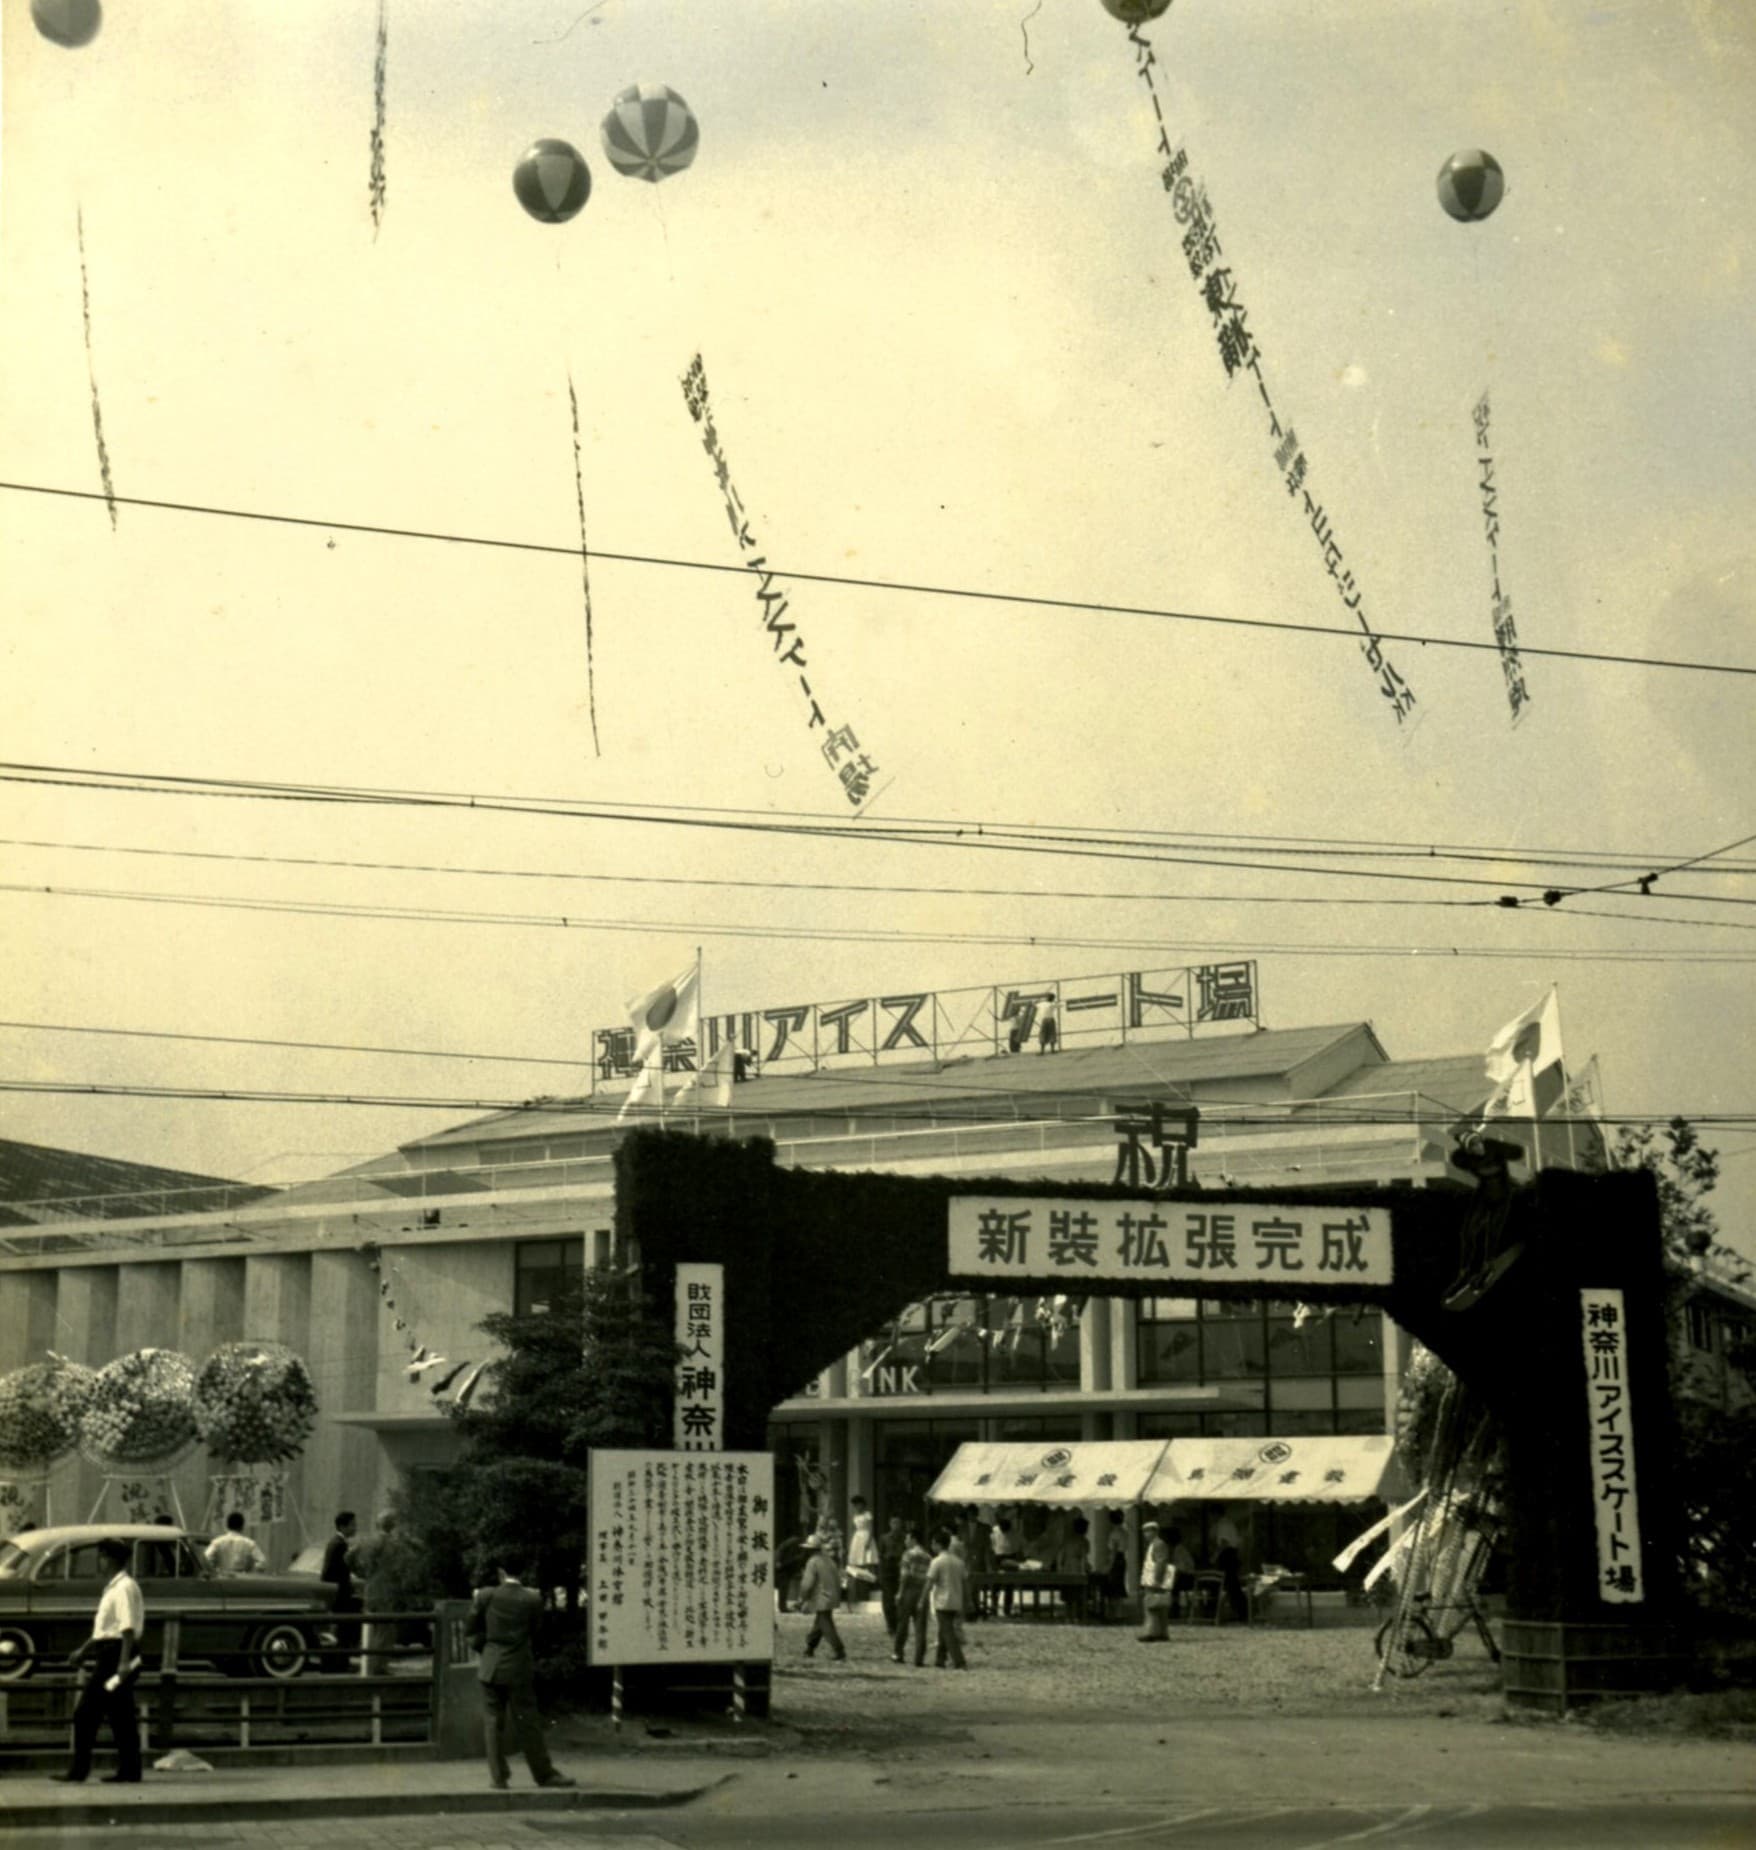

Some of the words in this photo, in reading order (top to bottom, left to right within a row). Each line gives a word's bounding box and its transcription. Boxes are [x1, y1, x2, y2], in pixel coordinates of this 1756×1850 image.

[1114, 1102, 1201, 1187] 祝
[977, 1207, 1370, 1272] 新装拡張完成
[680, 1282, 717, 1450] 財団法人神奈
[1587, 1302, 1637, 1594] 神奈川アイススケート場
